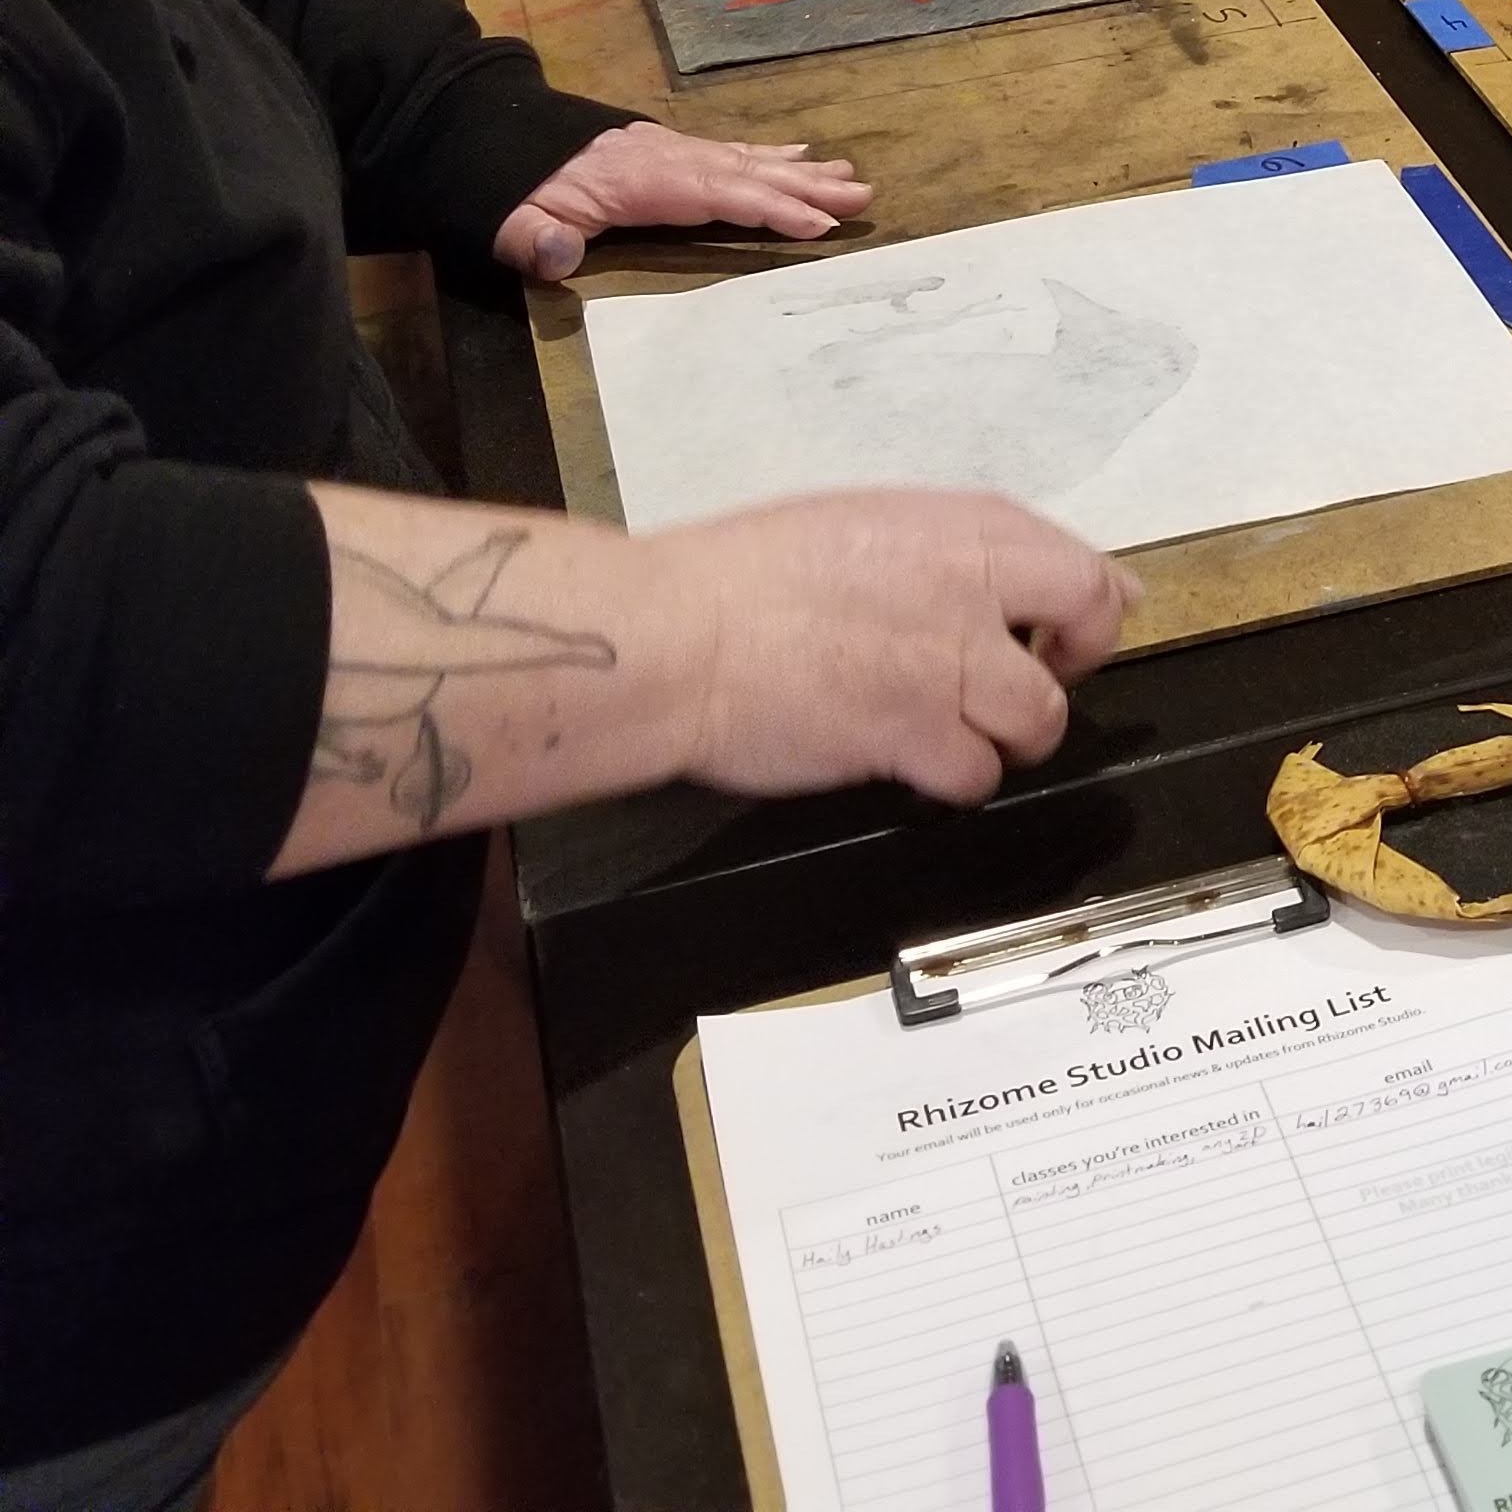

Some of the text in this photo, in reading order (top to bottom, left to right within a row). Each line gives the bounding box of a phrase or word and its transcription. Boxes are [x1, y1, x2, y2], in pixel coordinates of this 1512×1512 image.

[897, 985, 1392, 1133] Rhizome Studio Mailing List
[1383, 1058, 1434, 1085] email
[876, 1007, 1426, 1163] Your email will be used only for occasional news & updates from Rhizome Studio.
[1011, 1109, 1261, 1186] classes you're interested in
[1359, 1176, 1424, 1203] Please
[1427, 1160, 1473, 1185] print
[865, 1203, 922, 1226] name
[1398, 1192, 1453, 1215] Many
